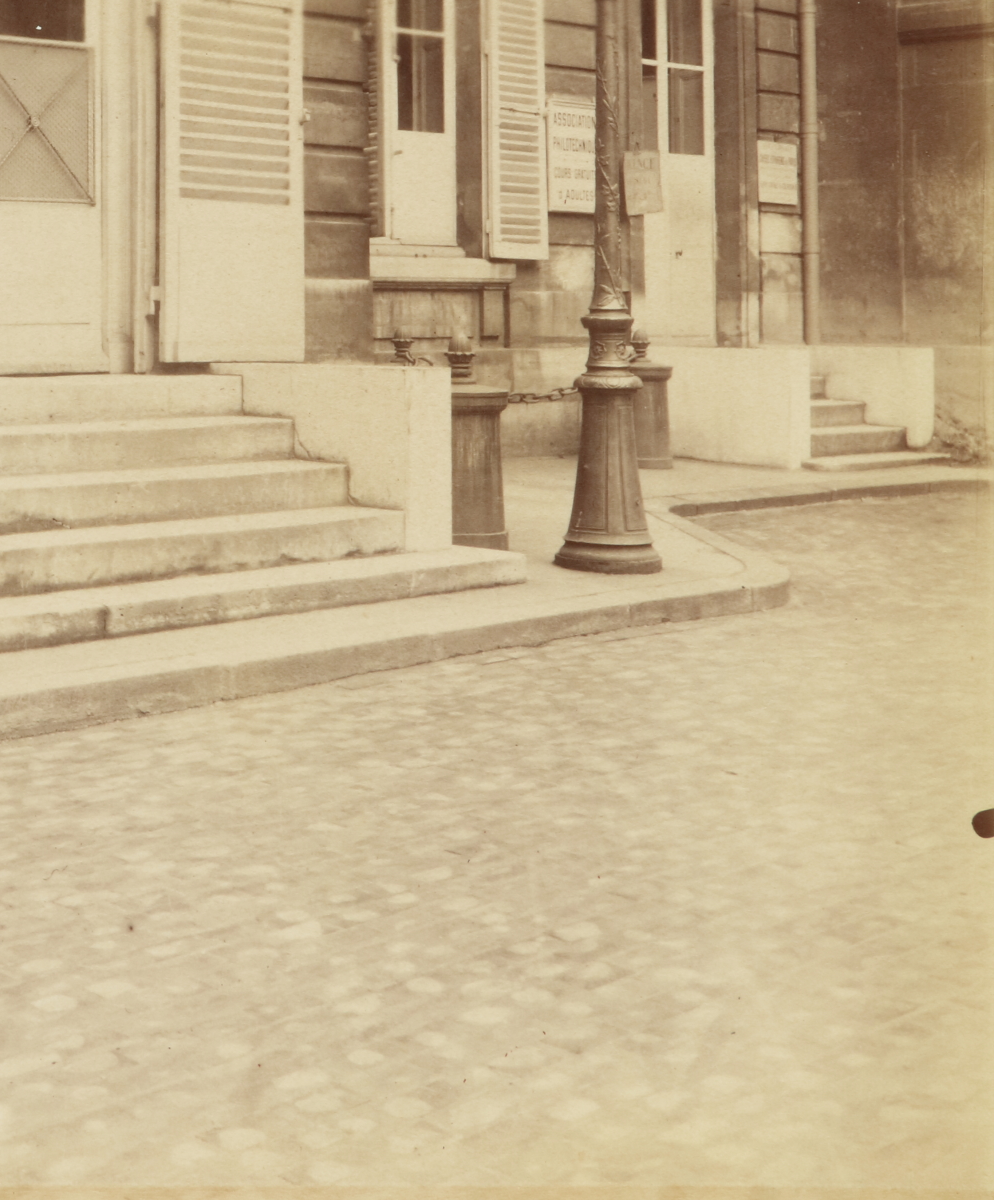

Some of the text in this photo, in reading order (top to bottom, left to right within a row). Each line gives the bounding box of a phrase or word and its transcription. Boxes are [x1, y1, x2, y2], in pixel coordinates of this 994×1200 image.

[553, 112, 595, 130] ASSOCIATION
[553, 136, 595, 154] PHILOTECHNIQU
[574, 168, 595, 180] GRATUIT
